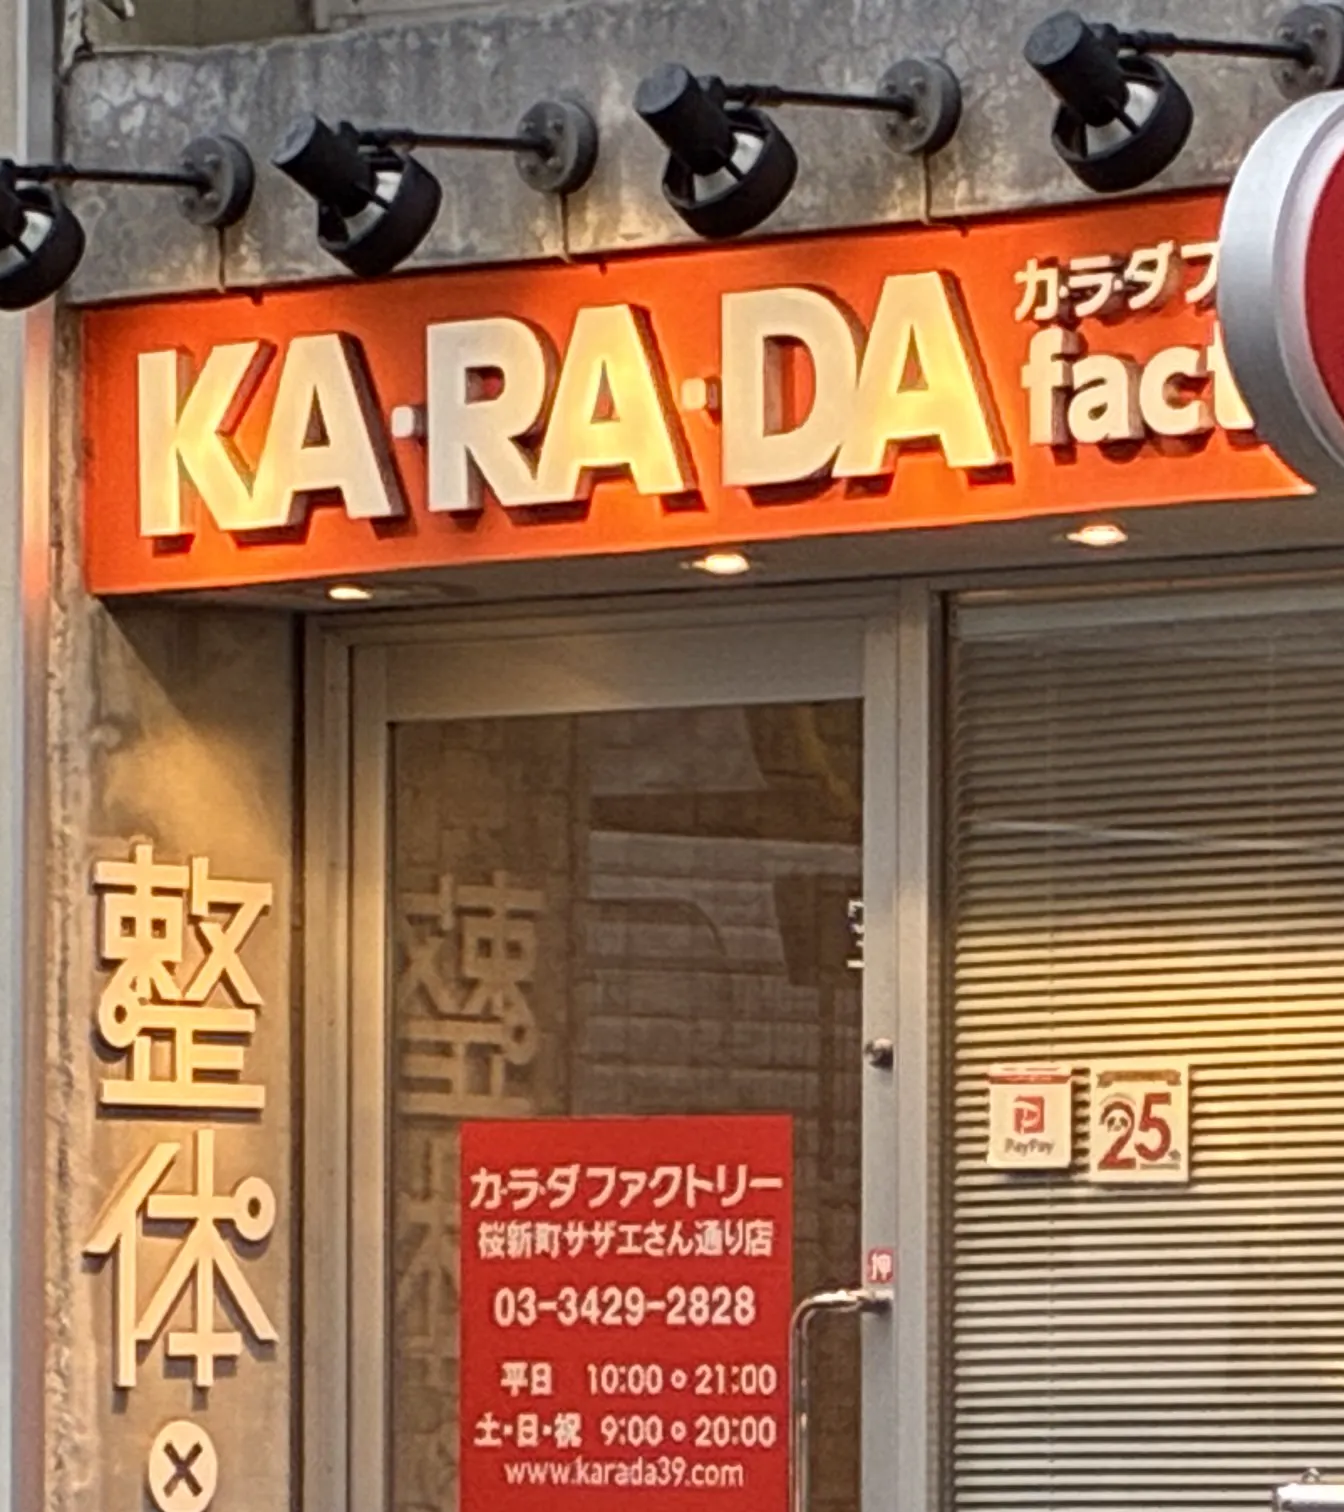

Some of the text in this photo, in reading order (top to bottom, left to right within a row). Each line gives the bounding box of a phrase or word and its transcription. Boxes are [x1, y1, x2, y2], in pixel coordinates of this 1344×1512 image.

[1004, 1137, 1054, 1158] PayPay
[477, 1220, 775, 1259] 桜新町サザエさん通り店
[493, 1286, 756, 1327] 03-3429-2828
[500, 1362, 777, 1397] 平日 10:00 21:00
[600, 1415, 663, 1448] 9:00
[694, 1415, 777, 1448] 20:00
[504, 1455, 744, 1488] www.karada39.com
